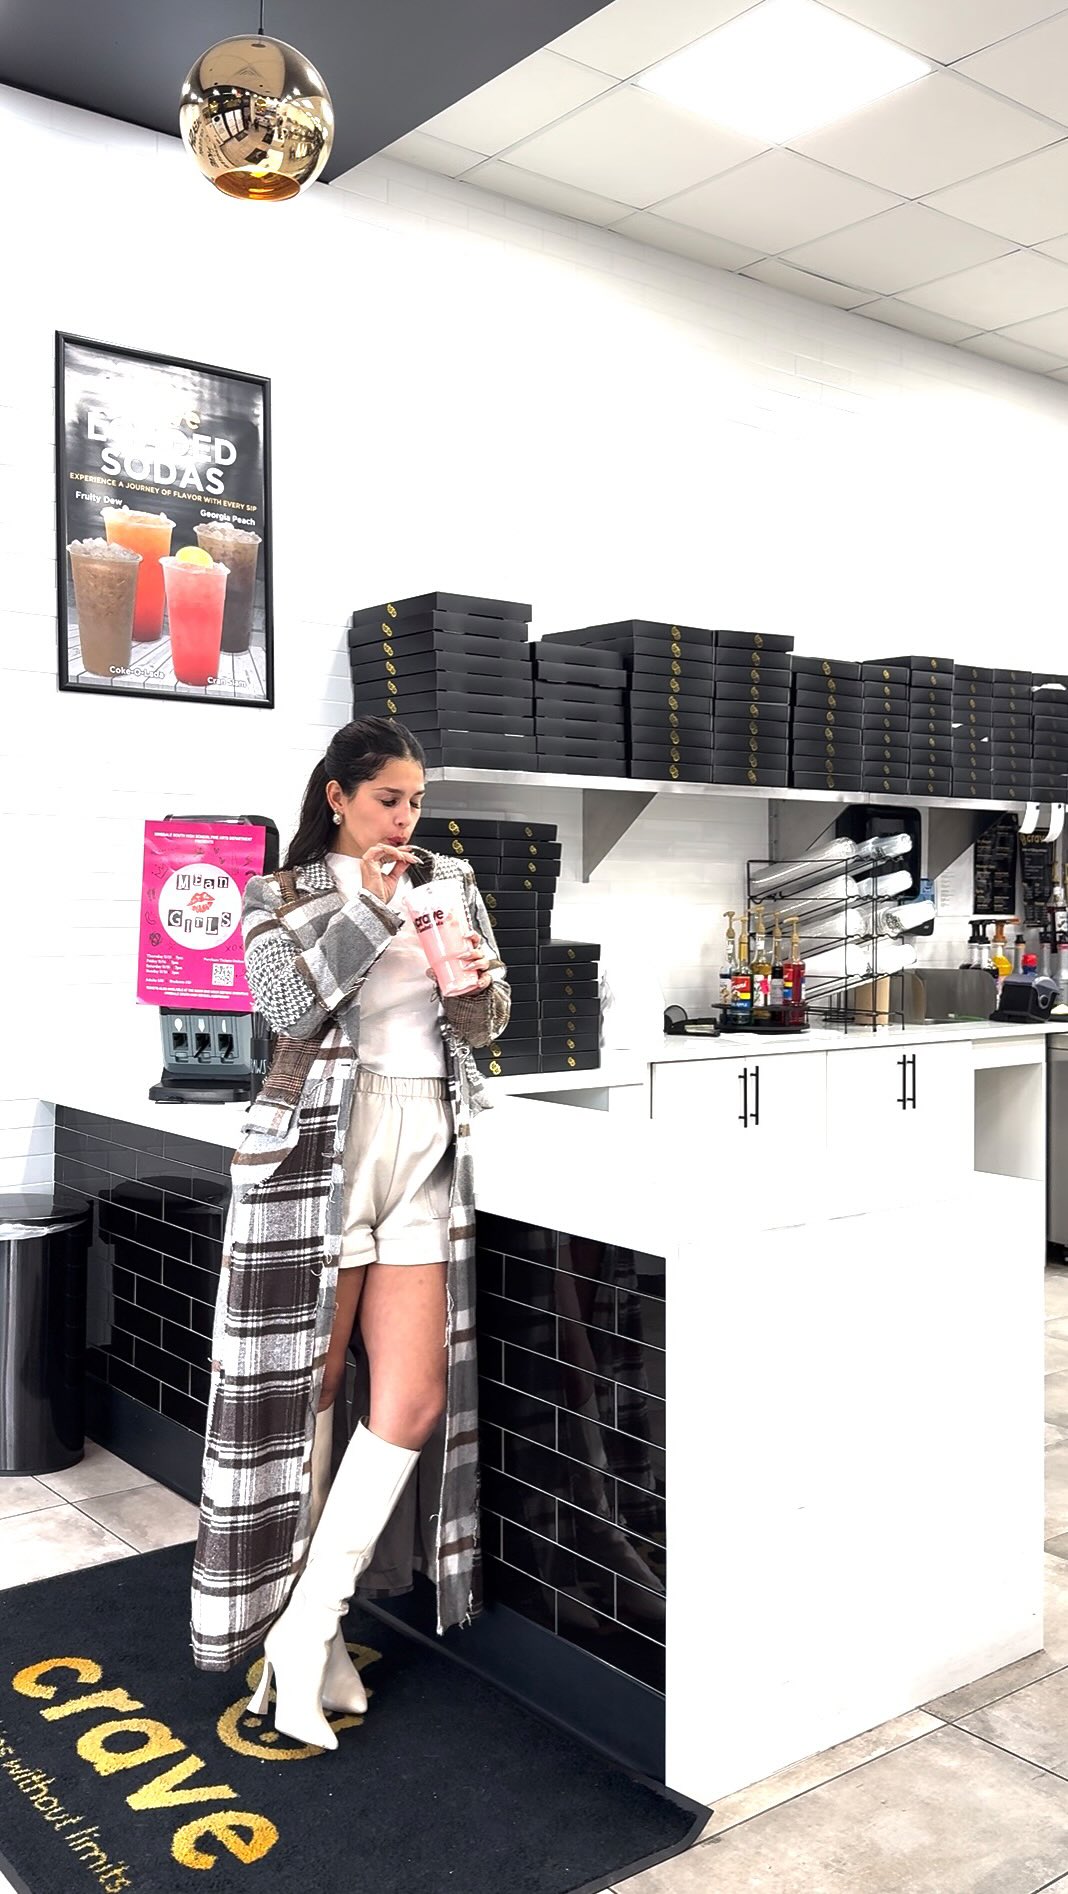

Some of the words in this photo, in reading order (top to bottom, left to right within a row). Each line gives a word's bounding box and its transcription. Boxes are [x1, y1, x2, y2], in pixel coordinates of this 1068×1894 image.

[100, 446, 225, 495] SODAS
[69, 472, 117, 487] EXPERIENCE
[125, 482, 160, 494] JOURNEY
[161, 488, 172, 496] OF
[173, 490, 203, 502] FLAVOR
[203, 496, 222, 506] WITH
[222, 500, 245, 511] EVERY
[246, 504, 258, 512] SIP
[75, 490, 101, 504] Fruity
[103, 495, 123, 506] Dew
[200, 509, 231, 522] Georgia
[232, 515, 256, 526] Peach
[207, 676, 226, 686] Cran
[1026, 833, 1046, 844] crav
[11, 1656, 280, 1870] crave
[1, 1757, 86, 1831] without
[64, 1825, 132, 1893] limits
